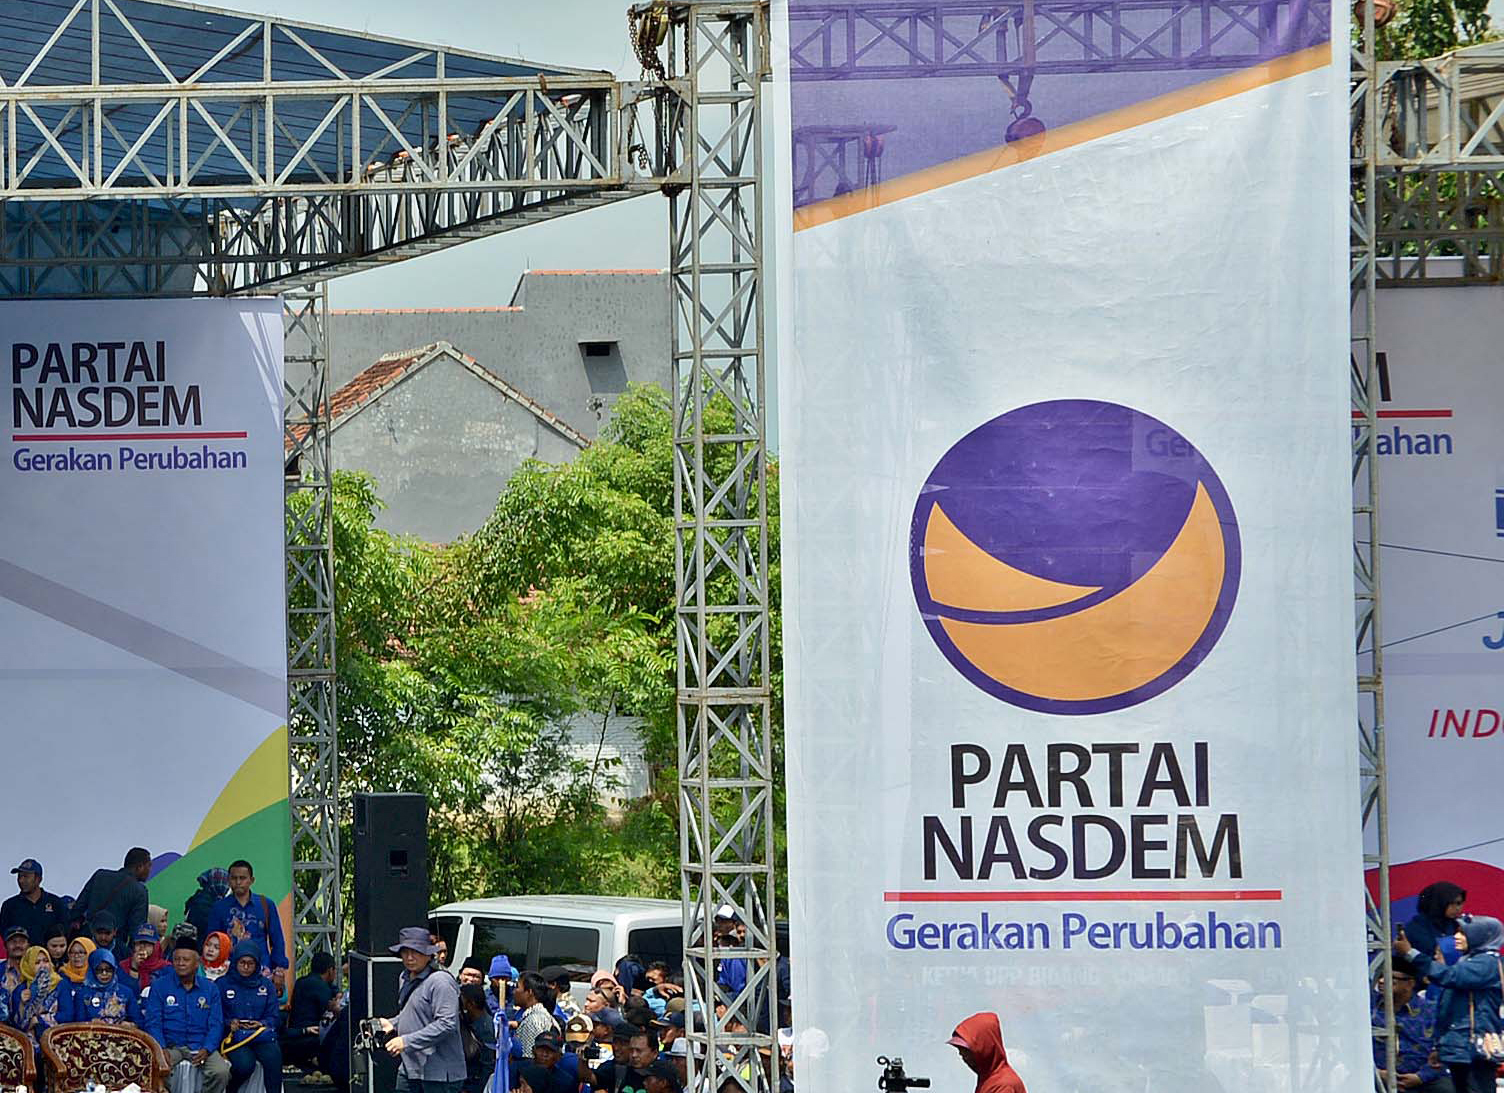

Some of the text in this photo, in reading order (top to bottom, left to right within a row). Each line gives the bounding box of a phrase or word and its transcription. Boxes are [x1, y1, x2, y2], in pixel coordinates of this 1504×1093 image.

[12, 340, 166, 384] PARTAI
[12, 384, 202, 428] NASDEM
[13, 447, 247, 472] Gerakan Perubahan
[950, 741, 1210, 809] PARTAI
[923, 813, 1242, 880] NASDEM
[886, 911, 1283, 953] Gerakan Perubahan
